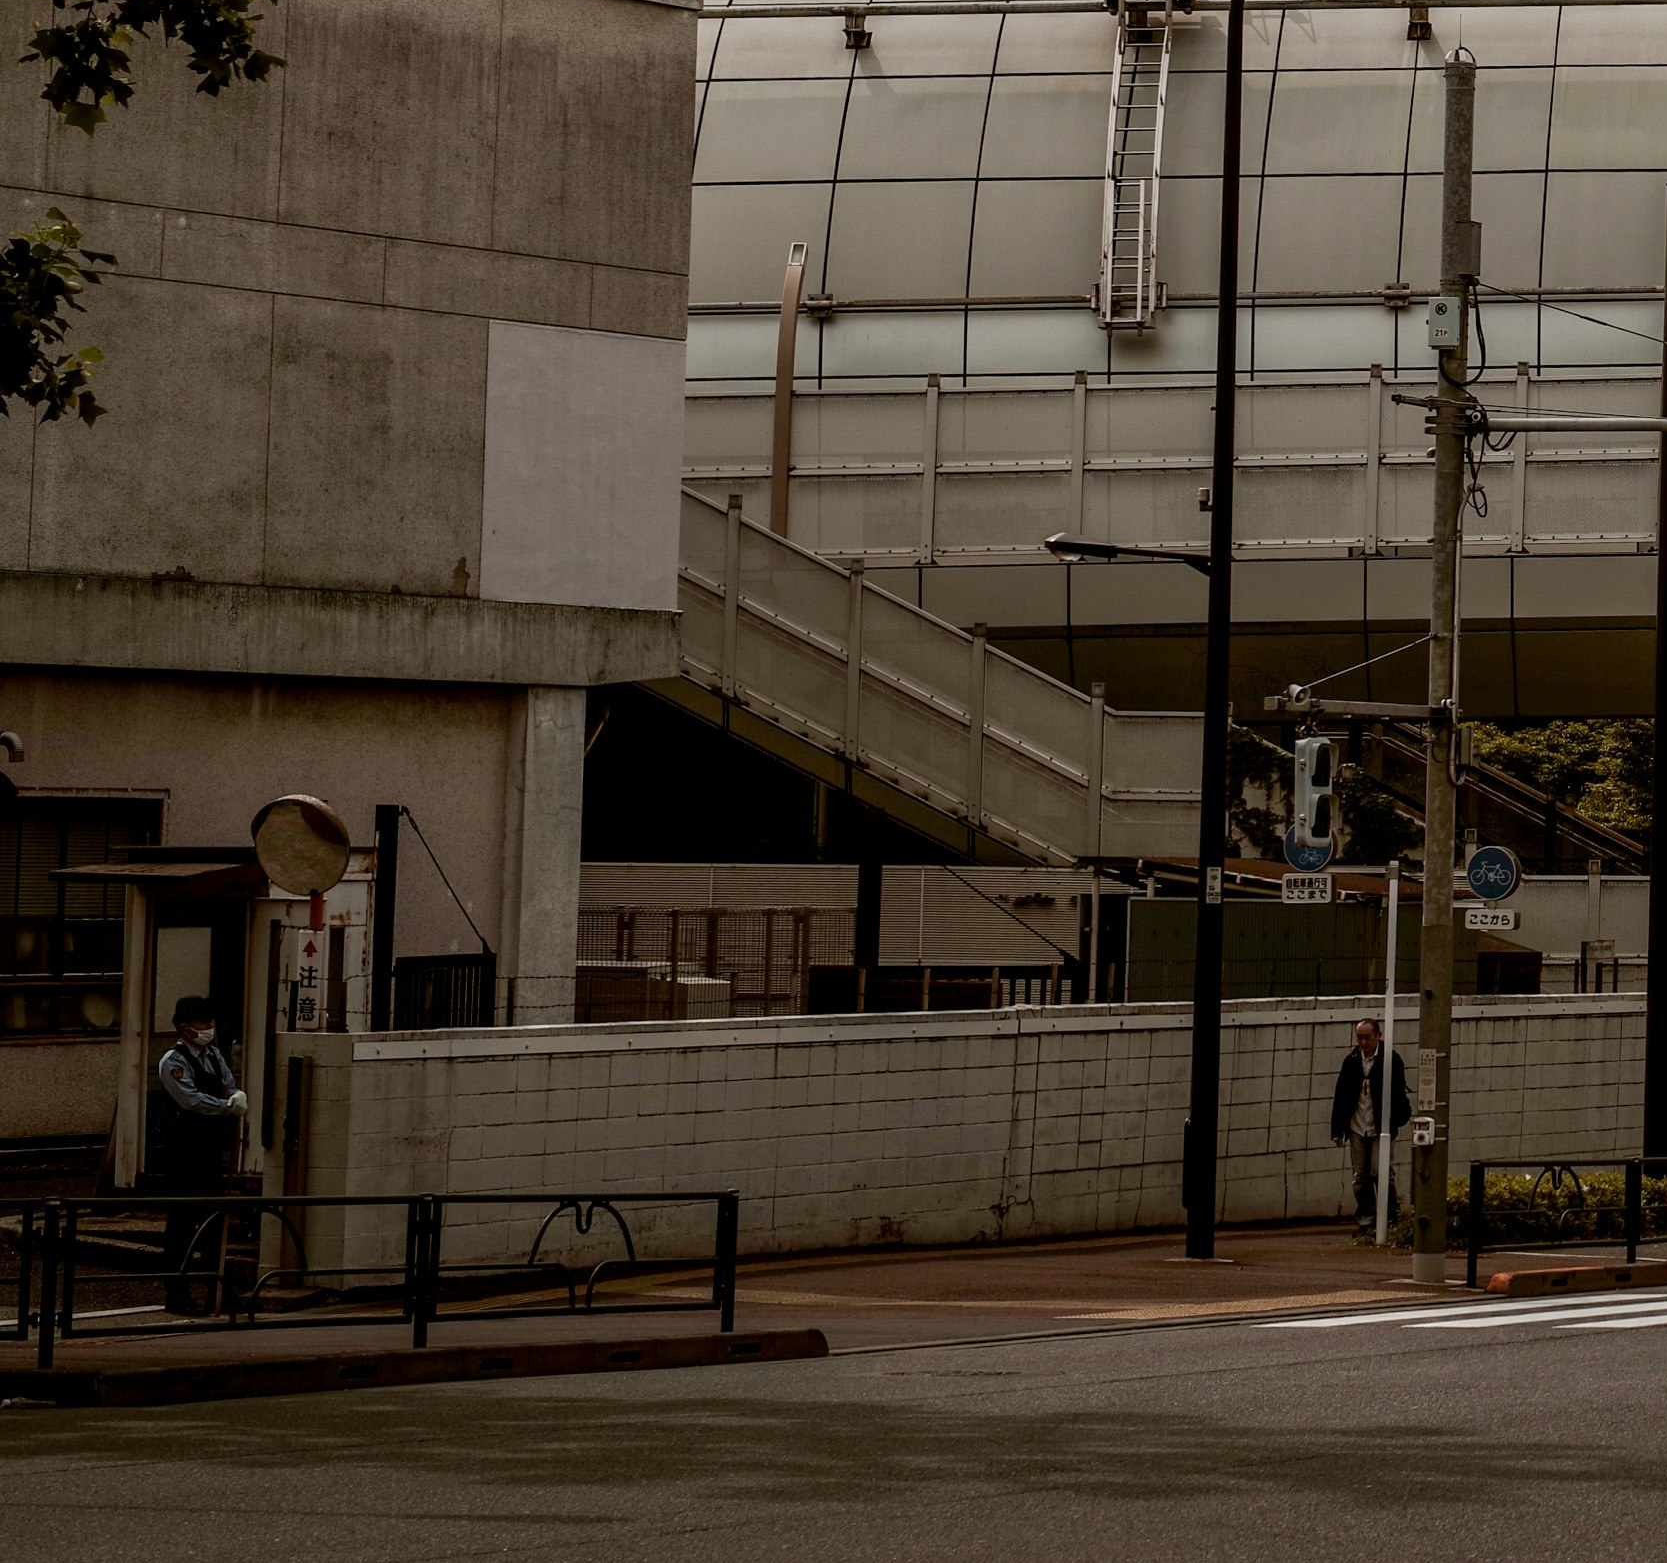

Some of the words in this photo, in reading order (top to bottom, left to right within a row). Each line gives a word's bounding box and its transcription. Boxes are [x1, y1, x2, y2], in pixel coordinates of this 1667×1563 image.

[1286, 890, 1327, 899] ここまで
[1469, 914, 1510, 925] ここから
[298, 966, 318, 1022] 注意
